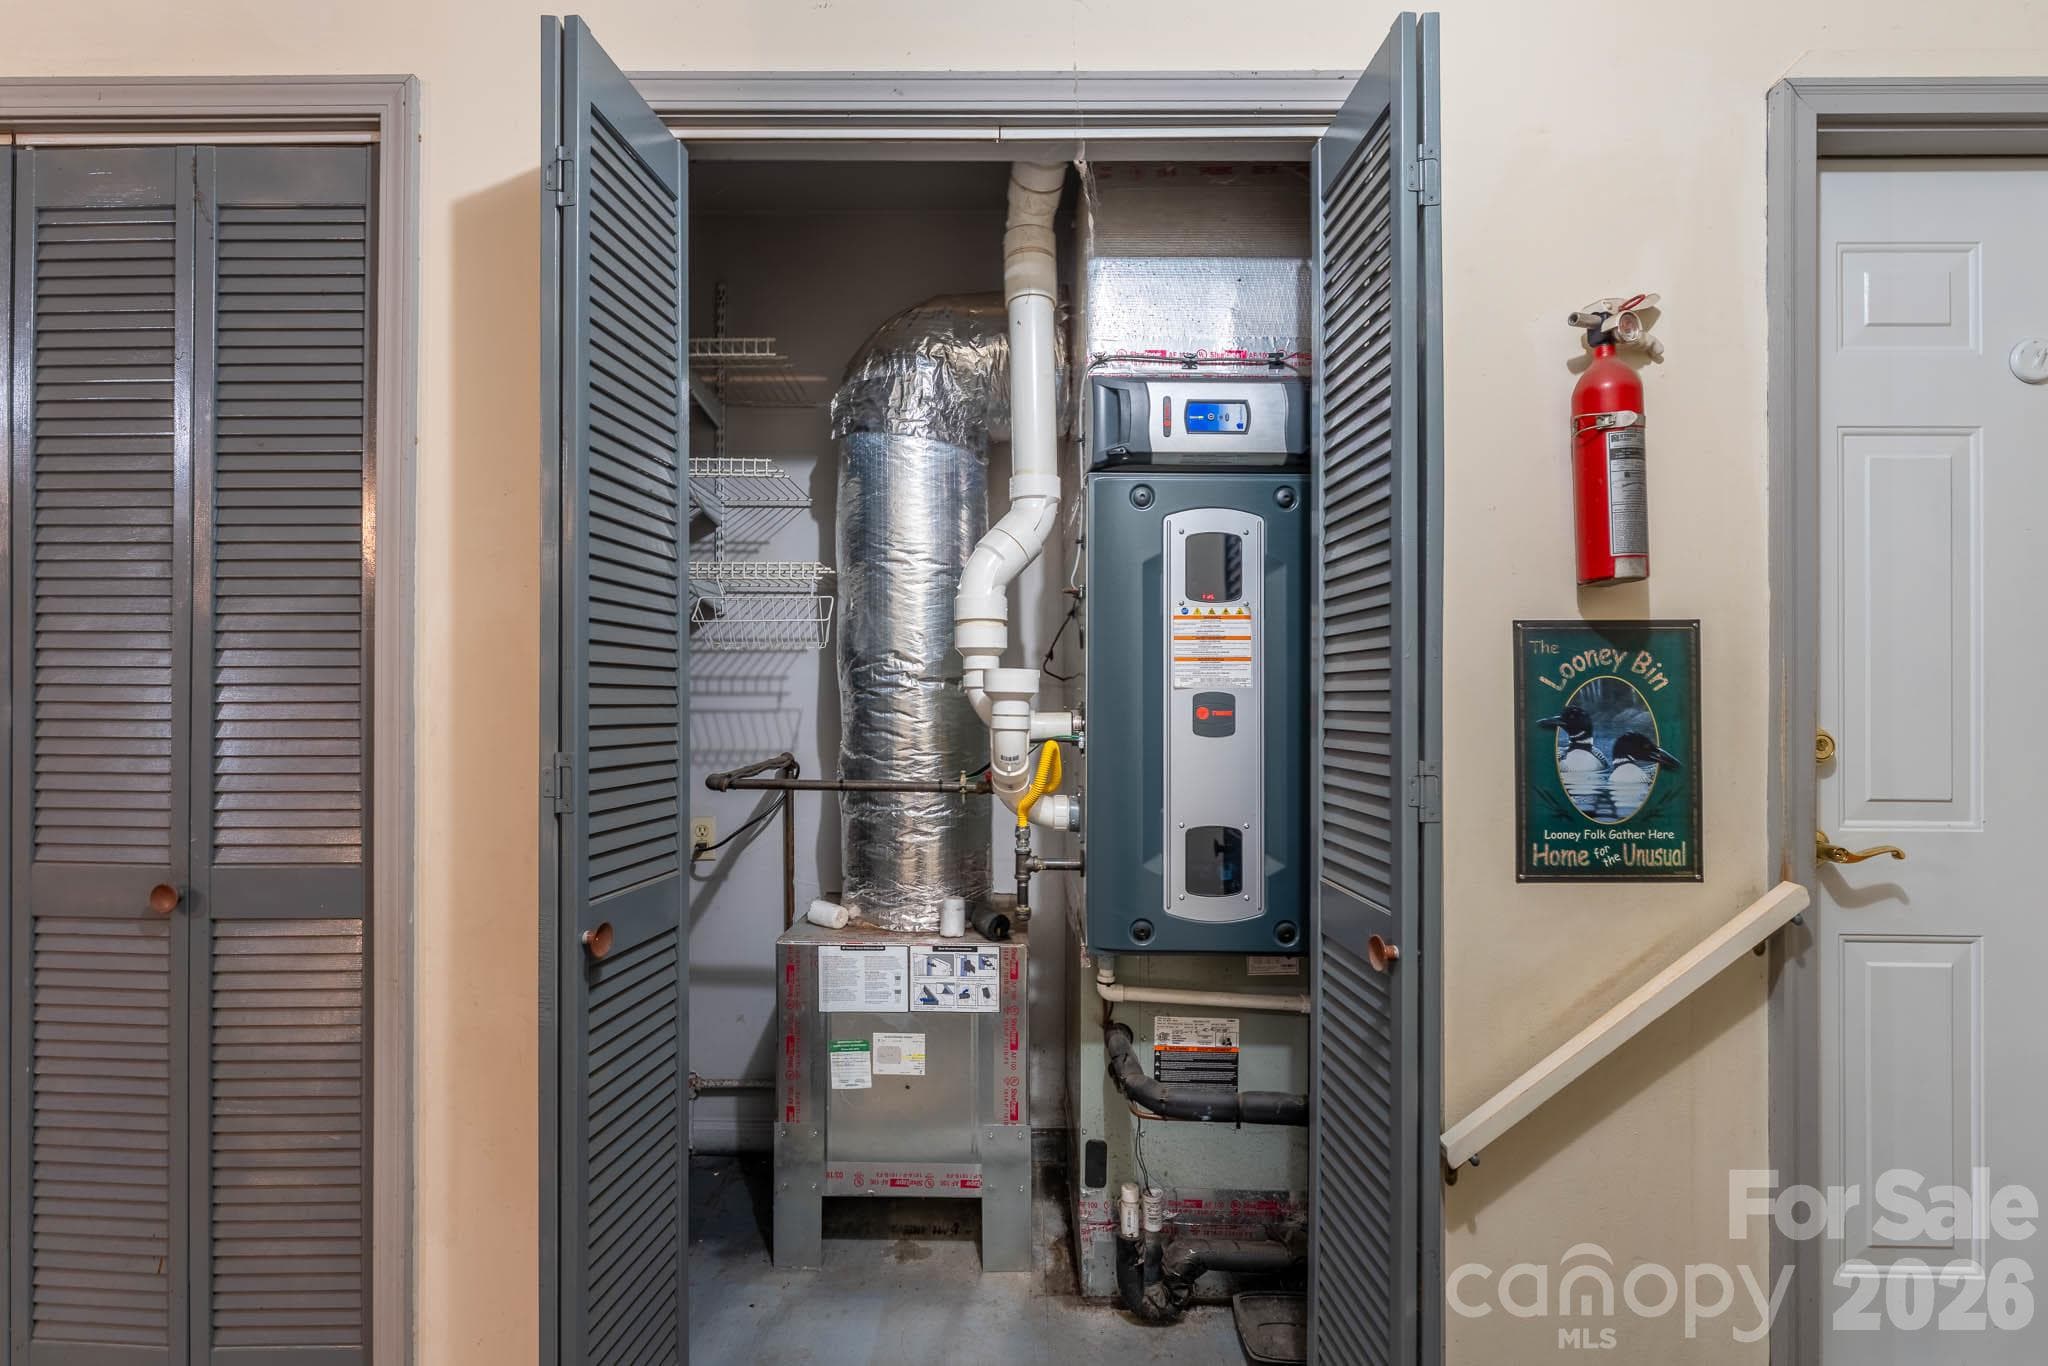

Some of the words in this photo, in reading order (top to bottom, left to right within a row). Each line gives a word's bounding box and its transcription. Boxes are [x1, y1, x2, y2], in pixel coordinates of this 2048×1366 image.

[1529, 640, 1560, 654] The
[1539, 648, 1627, 691] Looney
[1631, 650, 1669, 691] Bin
[1544, 830, 1581, 842] Looney
[1584, 829, 1606, 840] Folk
[1609, 829, 1646, 840] Gather
[1648, 829, 1675, 840] Here
[1532, 842, 1591, 867] Home
[1594, 845, 1610, 859] for
[1603, 853, 1622, 867] the
[1623, 841, 1687, 867] Unusual
